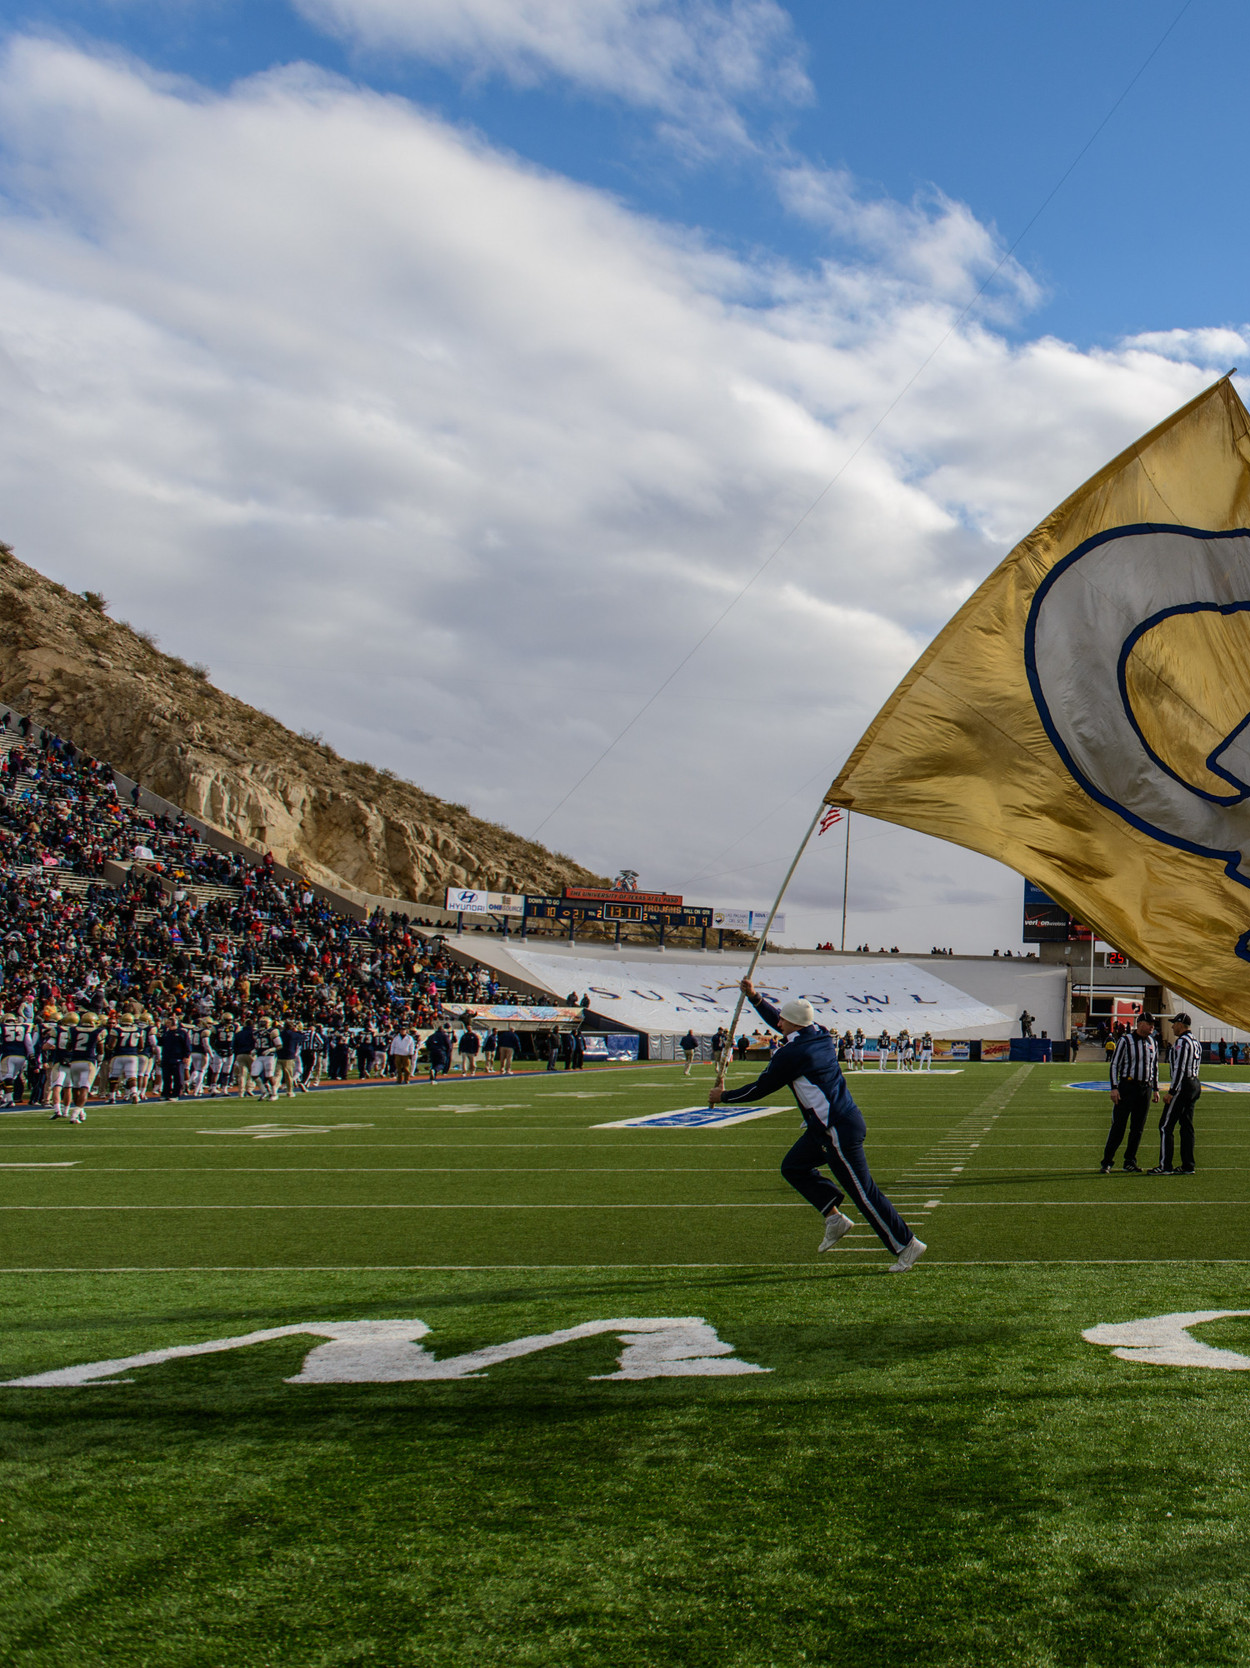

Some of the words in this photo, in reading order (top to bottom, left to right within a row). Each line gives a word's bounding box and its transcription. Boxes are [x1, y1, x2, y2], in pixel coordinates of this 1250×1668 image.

[582, 891, 619, 899] UNIVERSITY
[448, 902, 485, 912] HYUNDAI
[546, 907, 556, 917] 10
[643, 904, 682, 914] TROJANS
[572, 909, 585, 919] 21
[597, 910, 602, 919] 2
[609, 906, 640, 919] 13:11
[643, 913, 649, 921] 2
[702, 917, 708, 927] 4
[1024, 919, 1050, 928] verizon
[1109, 952, 1124, 964] 25
[588, 986, 719, 1004] SUN
[675, 1006, 884, 1014] ASSOTION
[4, 1025, 26, 1042] 53
[74, 1032, 90, 1051] 2
